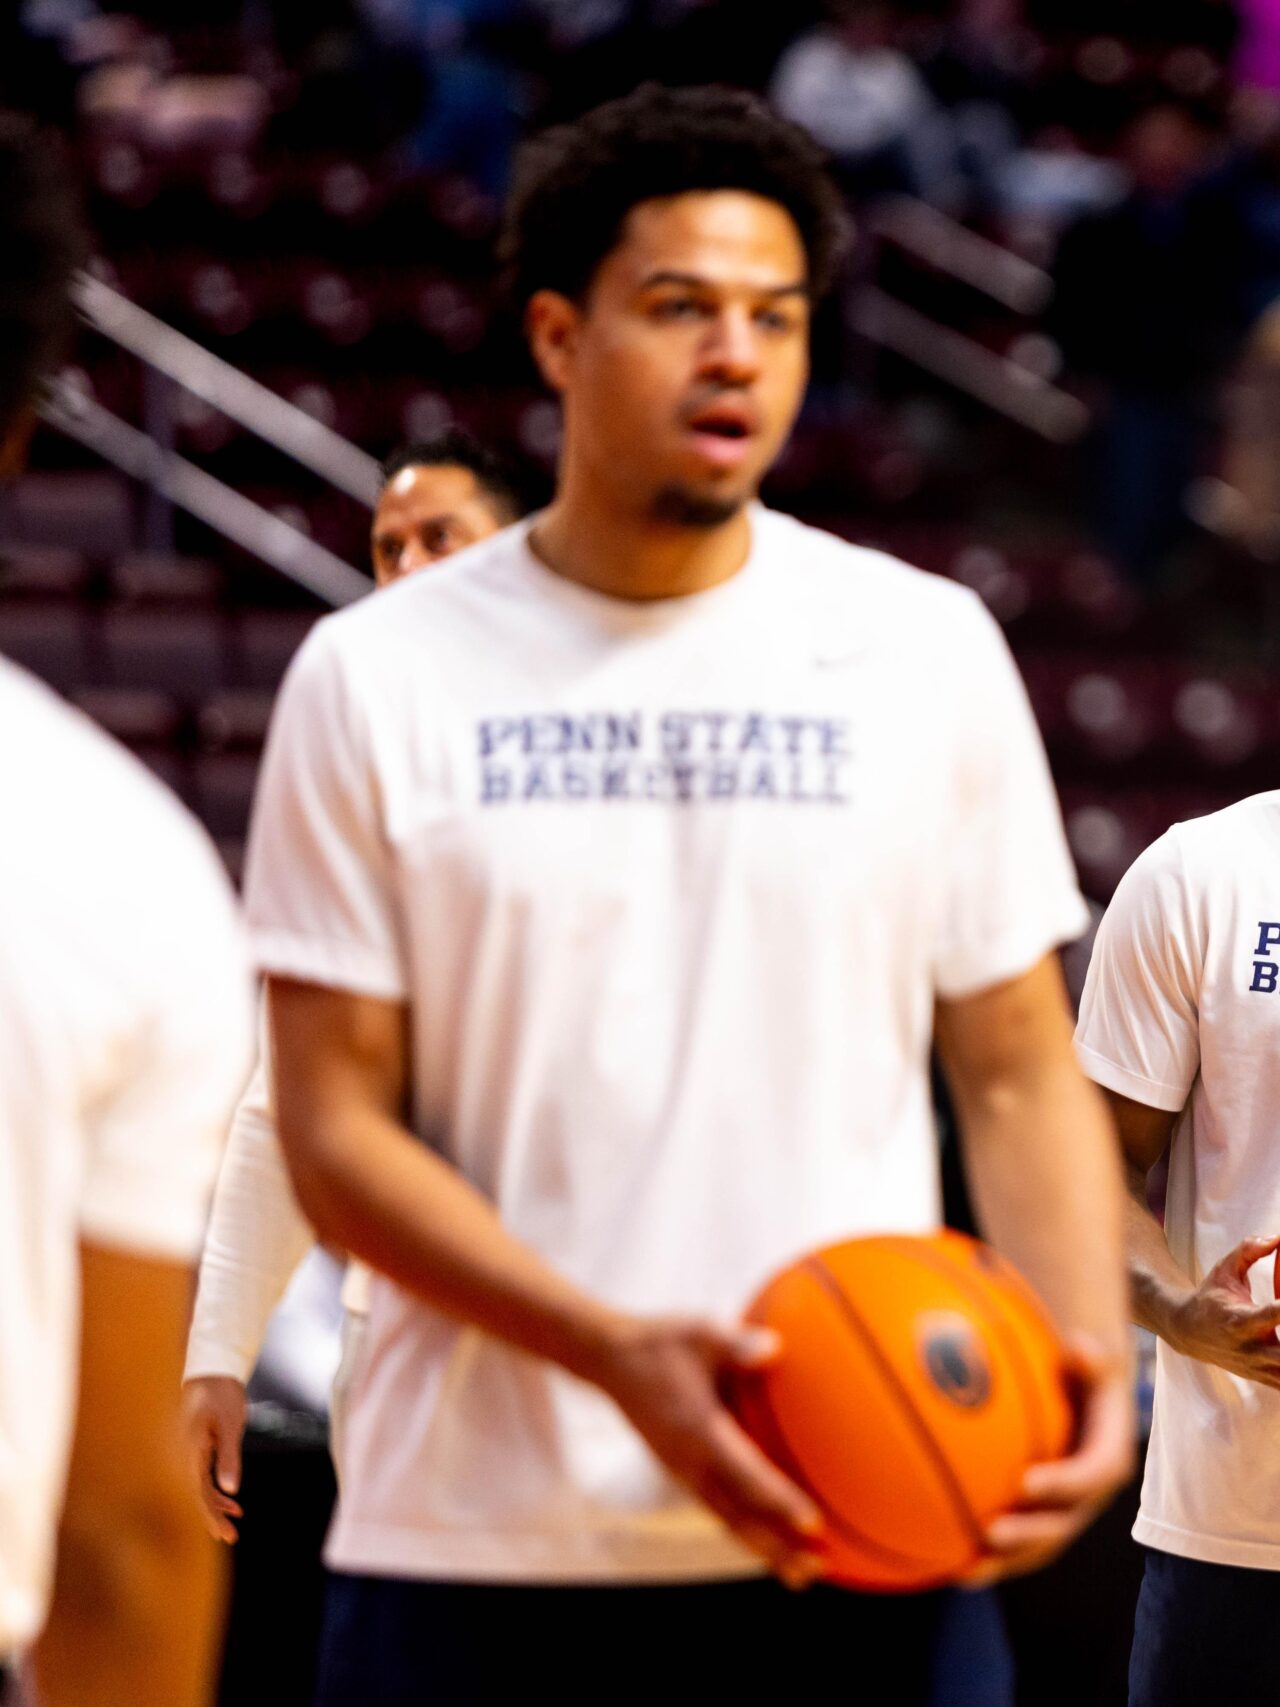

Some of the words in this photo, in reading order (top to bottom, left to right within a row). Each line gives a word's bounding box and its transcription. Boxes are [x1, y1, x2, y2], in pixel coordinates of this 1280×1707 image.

[476, 711, 642, 757] PENN
[658, 711, 851, 757] STATE
[478, 759, 852, 805] BASKETBALL
